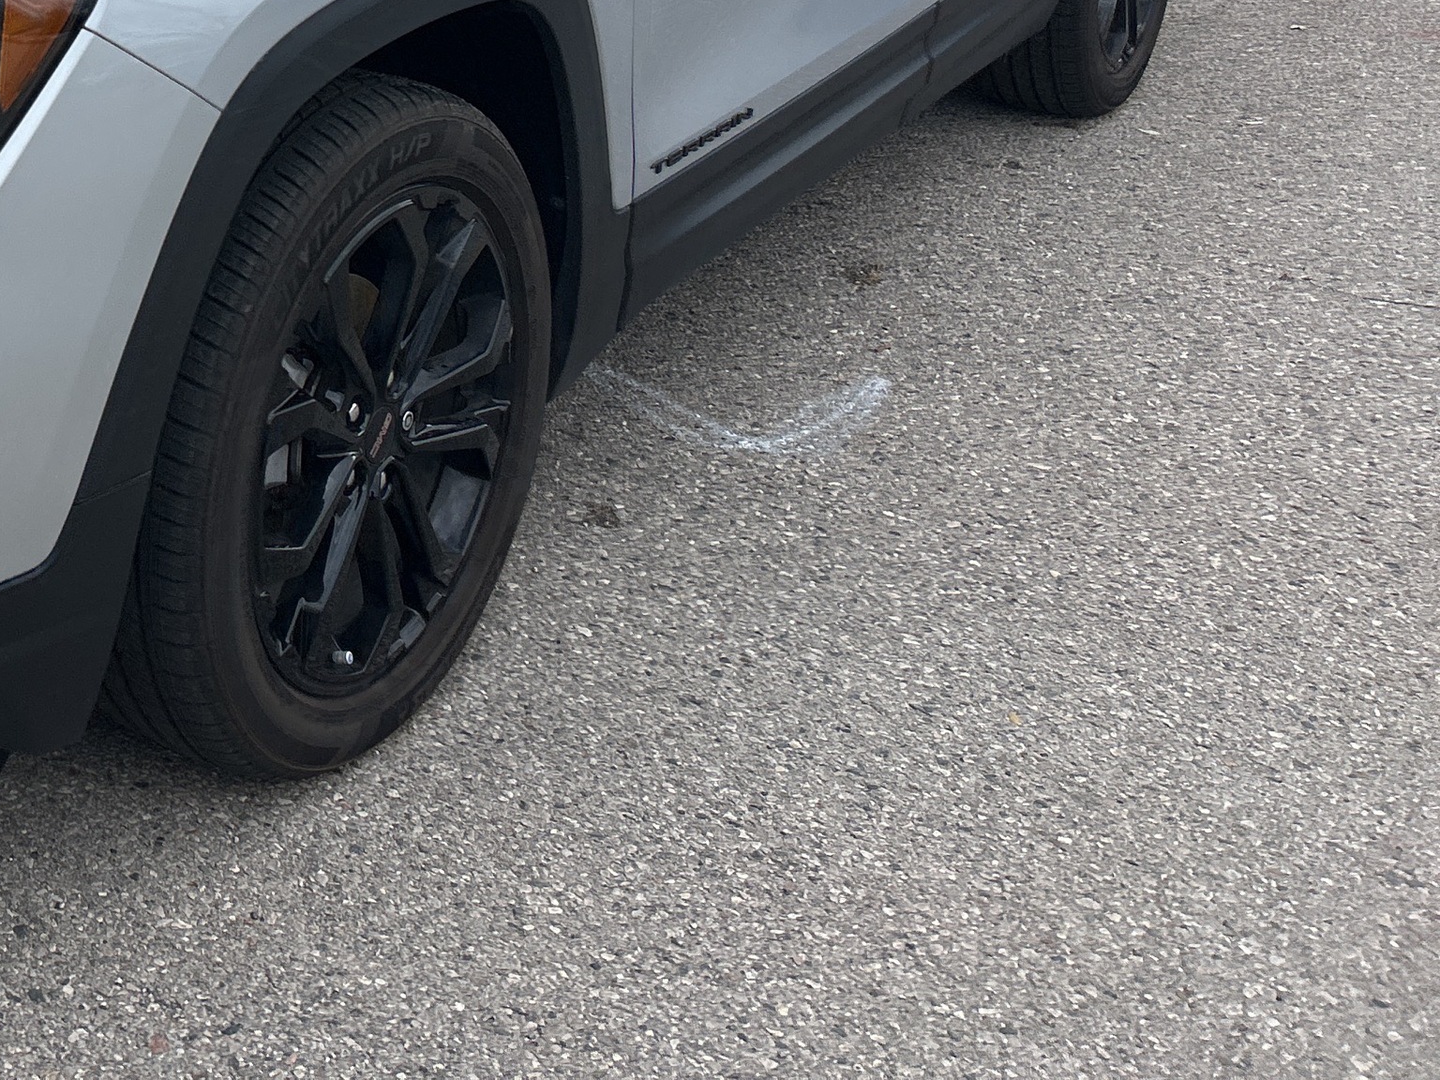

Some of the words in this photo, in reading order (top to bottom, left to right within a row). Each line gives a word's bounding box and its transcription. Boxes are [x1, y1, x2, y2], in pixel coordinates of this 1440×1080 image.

[390, 132, 432, 170] H/P
[650, 107, 753, 174] TERRAIN
[369, 412, 392, 458] GMC
